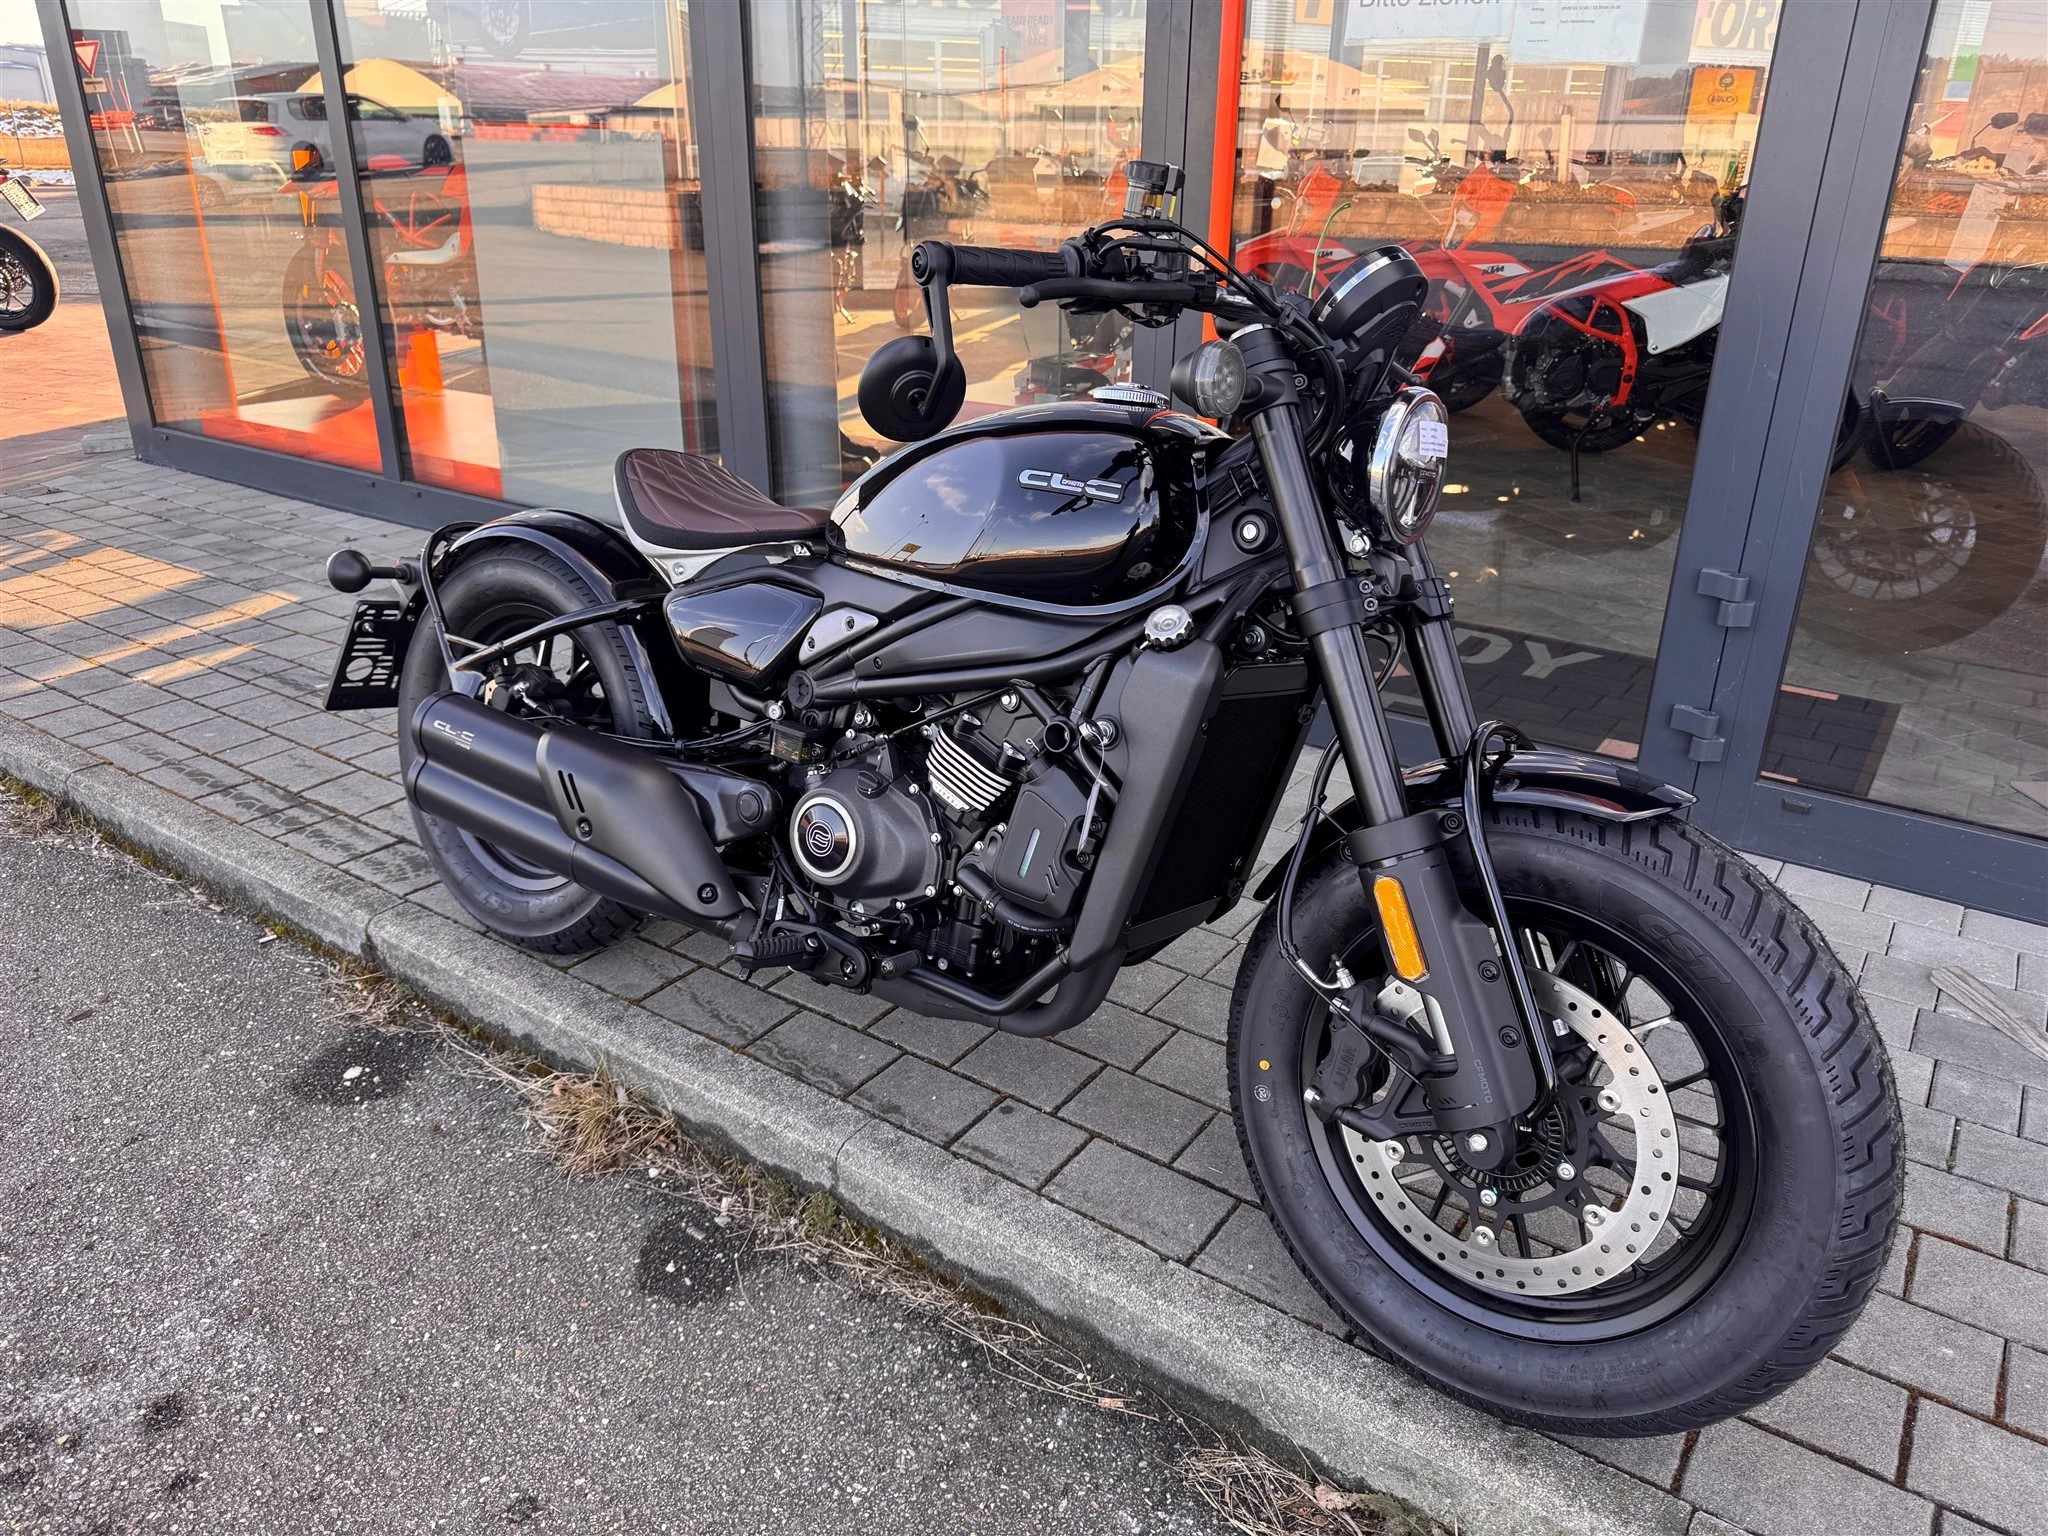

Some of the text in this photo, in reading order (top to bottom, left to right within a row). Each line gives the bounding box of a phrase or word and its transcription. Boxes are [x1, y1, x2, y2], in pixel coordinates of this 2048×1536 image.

[1482, 264, 1505, 275] KTM
[1636, 912, 1732, 987] CST
[1473, 1058, 1494, 1104] CFMOTO
[1398, 1120, 1433, 1129] CFMOTO
